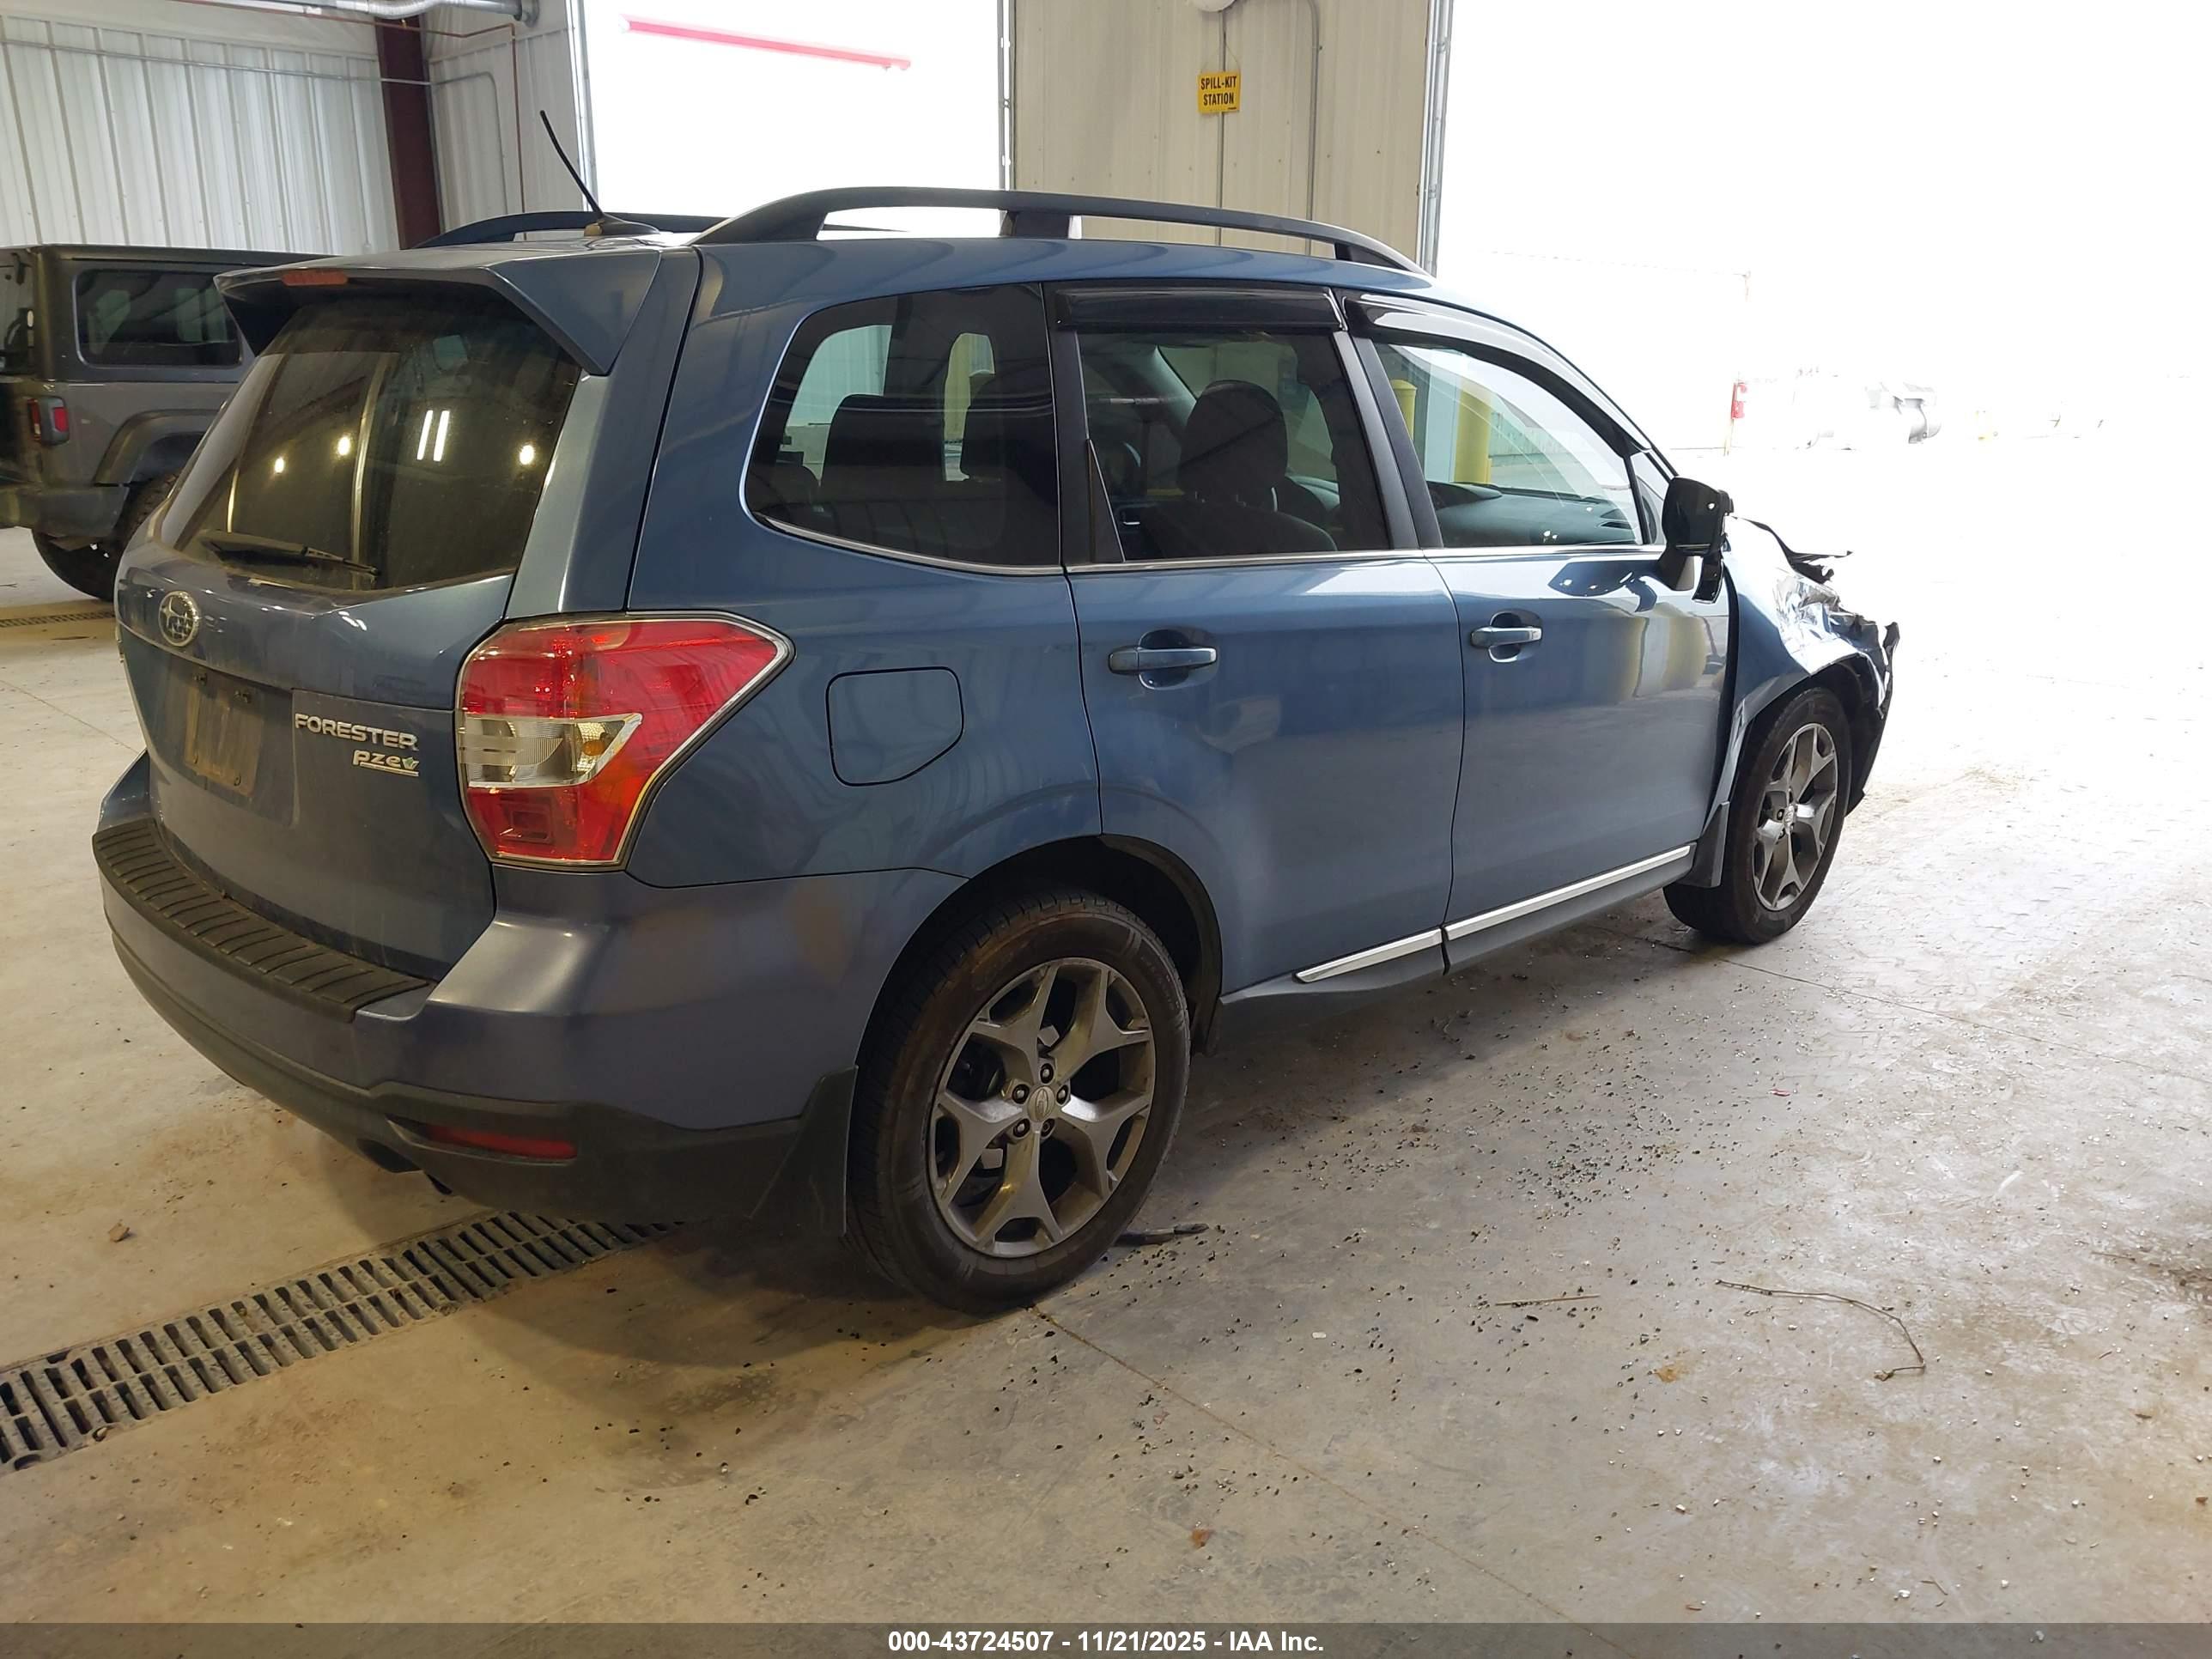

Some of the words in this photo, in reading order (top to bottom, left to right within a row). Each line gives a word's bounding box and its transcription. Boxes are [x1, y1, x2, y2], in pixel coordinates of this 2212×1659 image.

[1200, 76, 1237, 90] SPILL-KIT
[1203, 92, 1234, 106] STATION
[295, 713, 419, 751] FORESTER
